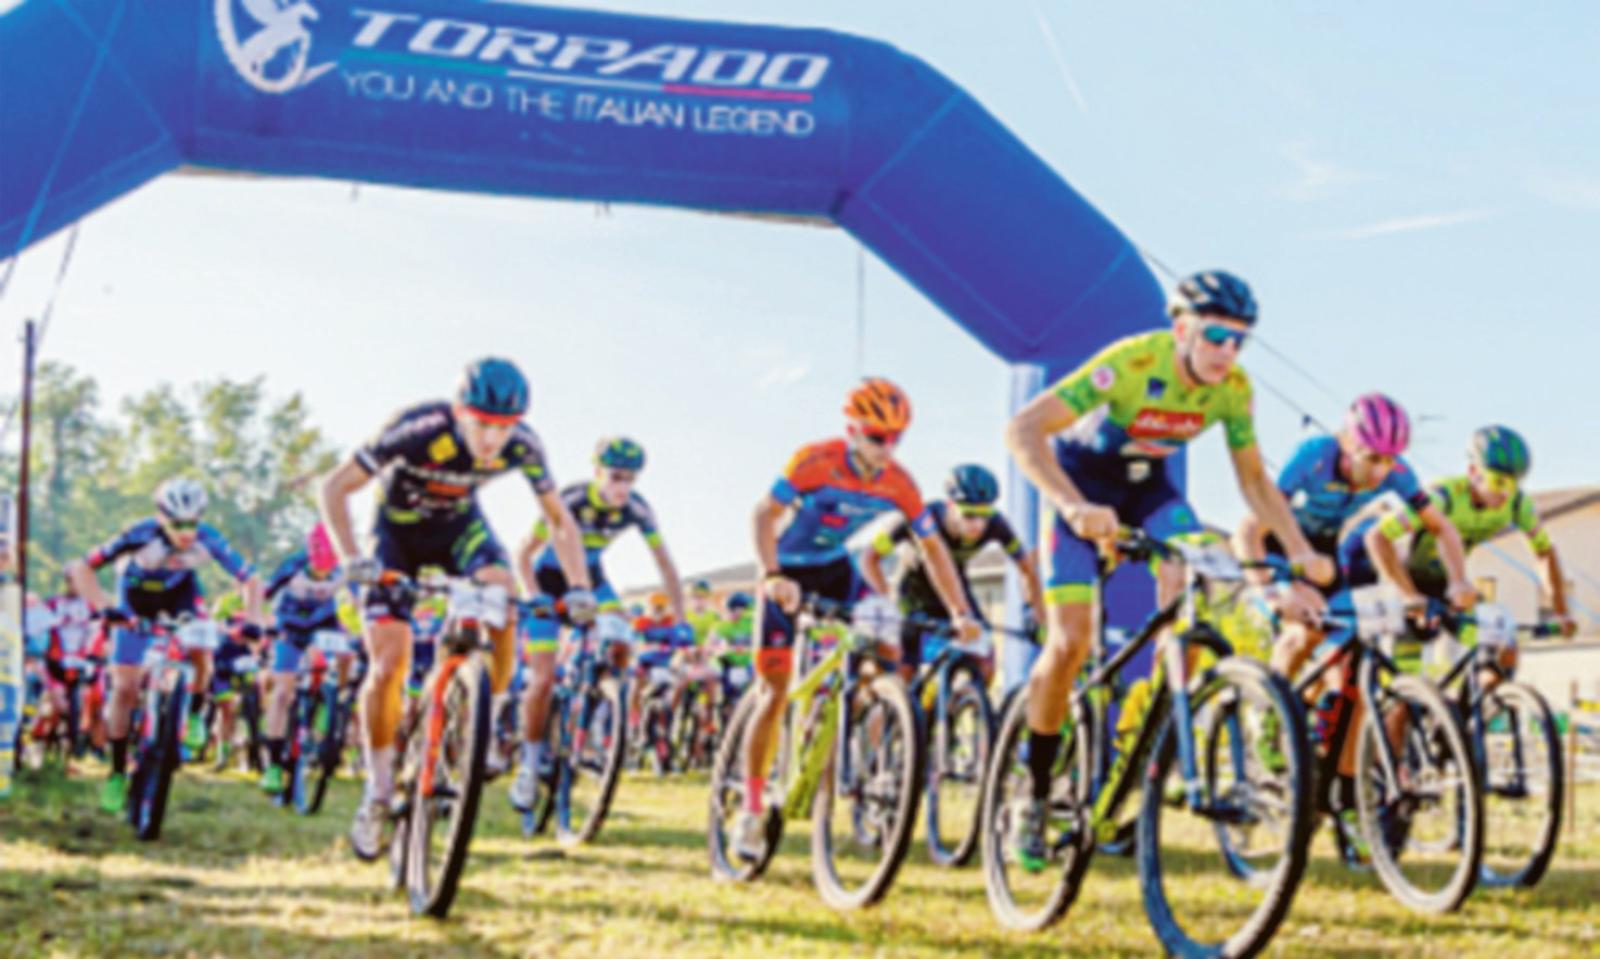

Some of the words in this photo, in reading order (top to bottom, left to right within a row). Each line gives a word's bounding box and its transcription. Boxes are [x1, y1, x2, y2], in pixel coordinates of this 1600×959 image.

[351, 8, 830, 89] TORPADO
[342, 69, 415, 100] YOU
[423, 77, 493, 109] AND
[504, 84, 564, 121] THE
[574, 92, 685, 130] ITALIAN
[693, 103, 815, 138] LEGEND
